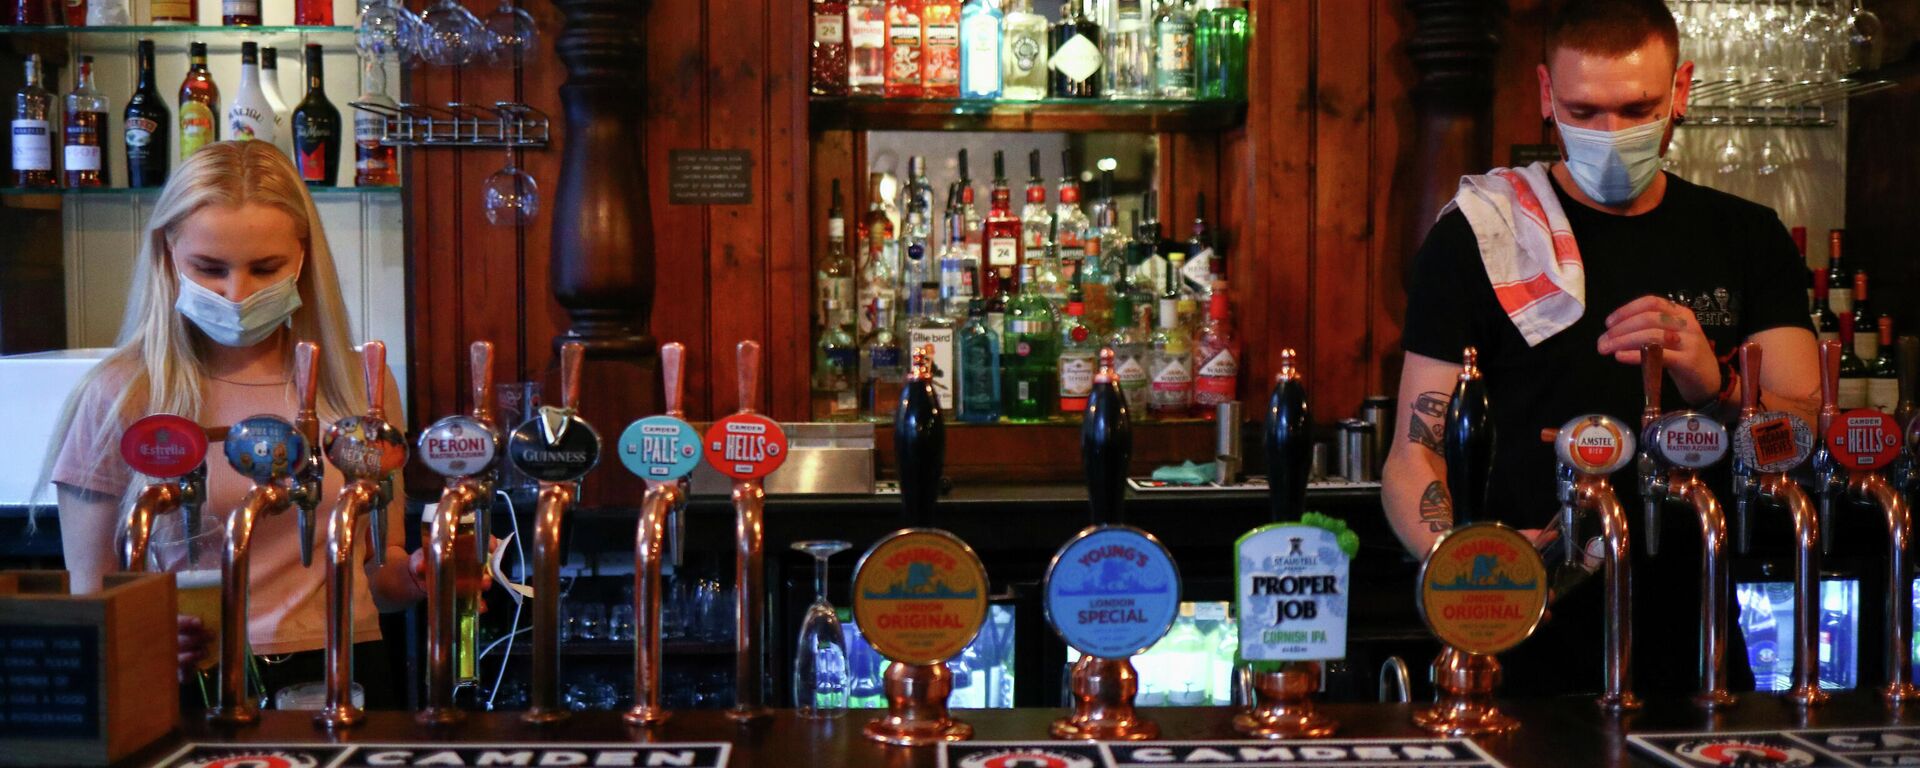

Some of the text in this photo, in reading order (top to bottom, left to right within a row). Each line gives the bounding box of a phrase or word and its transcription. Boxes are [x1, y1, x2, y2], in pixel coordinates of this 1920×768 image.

[820, 26, 837, 36] 24
[997, 248, 1010, 258] 24
[932, 333, 951, 342] bird
[428, 437, 485, 453] PERONI
[1580, 437, 1612, 446] AMSTEL
[1667, 430, 1719, 445] PERONI
[1847, 427, 1884, 453] HELLS
[139, 443, 186, 456] Estrella
[522, 449, 587, 463] GUINNESS
[642, 436, 680, 464] PALE
[725, 434, 766, 462] HELLS
[1078, 544, 1150, 568] YOUNG'S
[1450, 538, 1519, 563] YOUNG'S
[884, 547, 958, 572] YOUNG'S
[1251, 575, 1339, 596] PROPER
[896, 602, 944, 612] LONDON
[1089, 598, 1136, 608] LONDON
[1462, 594, 1505, 604] LONDON
[1077, 608, 1149, 625] SPECIAL
[1274, 599, 1318, 626] JOB
[1443, 604, 1525, 619] ORIGINAL
[877, 613, 965, 630] ORIGINAL
[1262, 630, 1327, 644] CORNISH IPA
[366, 751, 695, 767] CAMDEN
[1131, 746, 1457, 762] CAMDEN
